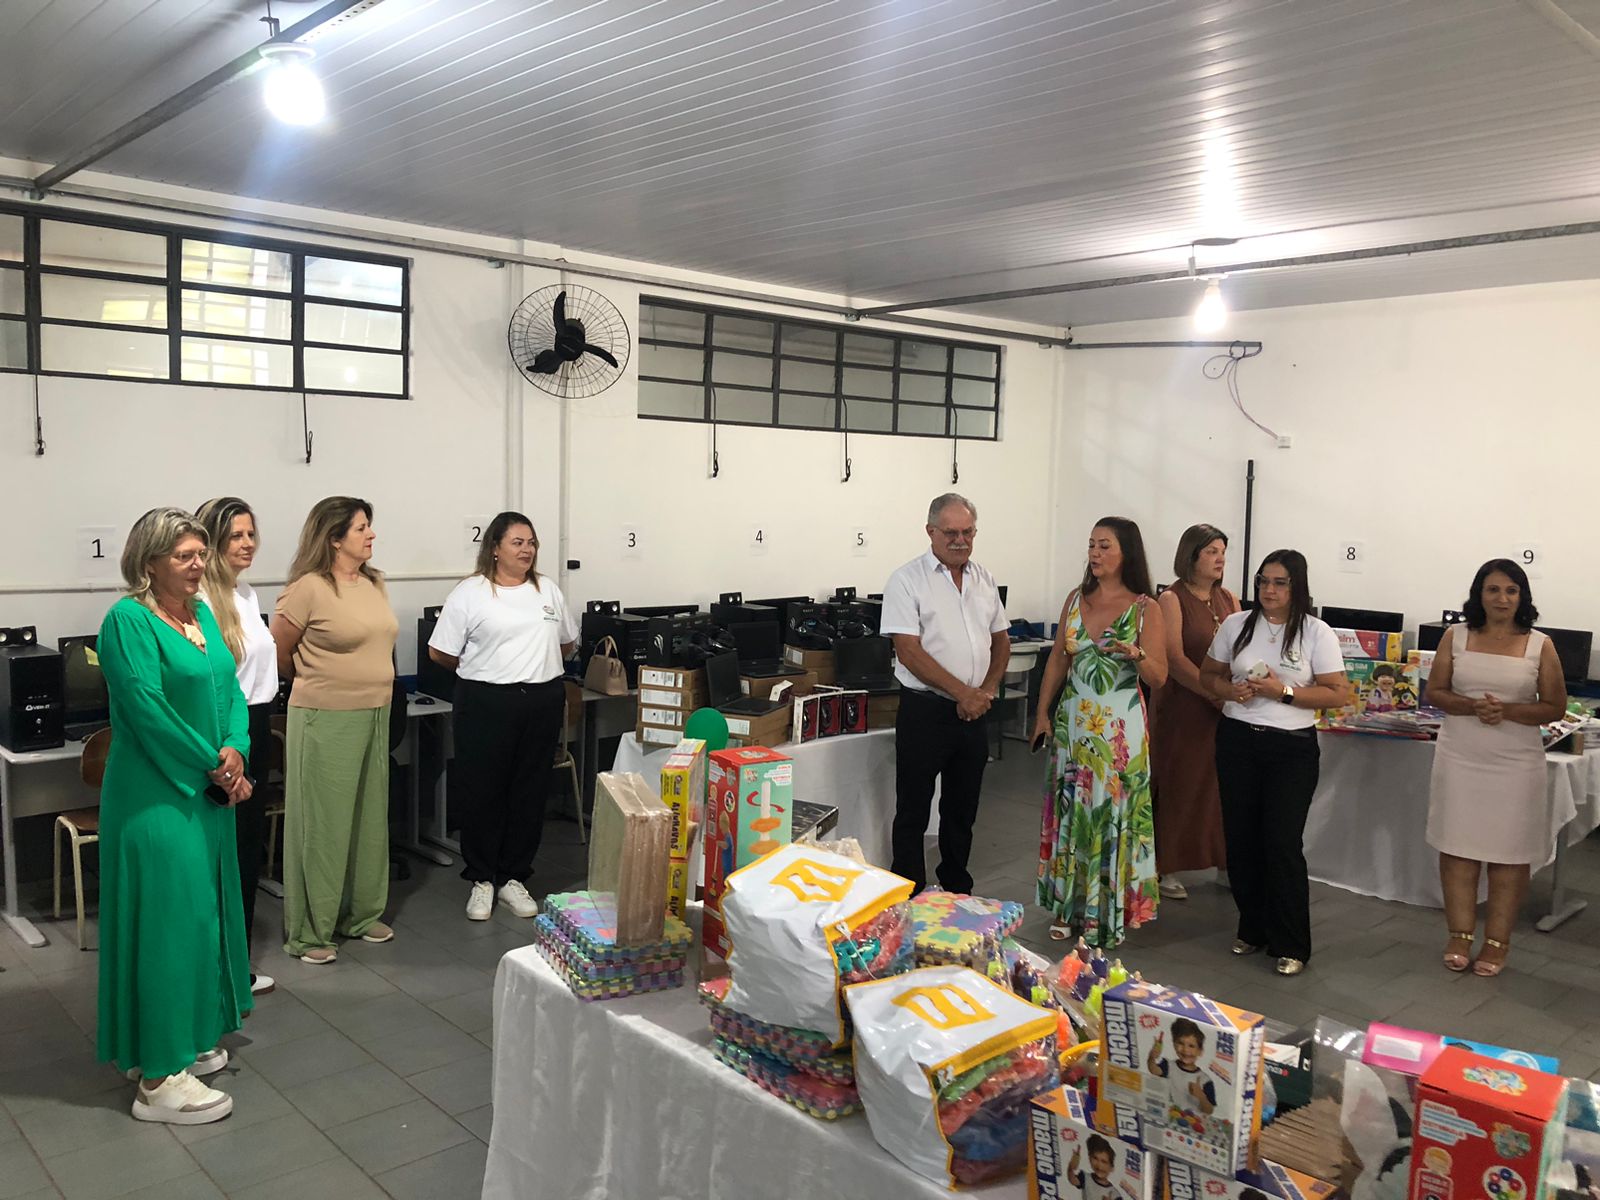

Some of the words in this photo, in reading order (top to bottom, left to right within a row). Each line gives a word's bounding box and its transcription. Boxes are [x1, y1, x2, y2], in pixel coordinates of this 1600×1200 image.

[471, 526, 482, 543] 2
[627, 532, 636, 548] 3
[755, 529, 763, 544] 4
[856, 532, 864, 547] 5
[91, 538, 105, 558] 1
[1346, 546, 1356, 560] 8
[1523, 549, 1534, 565] 9
